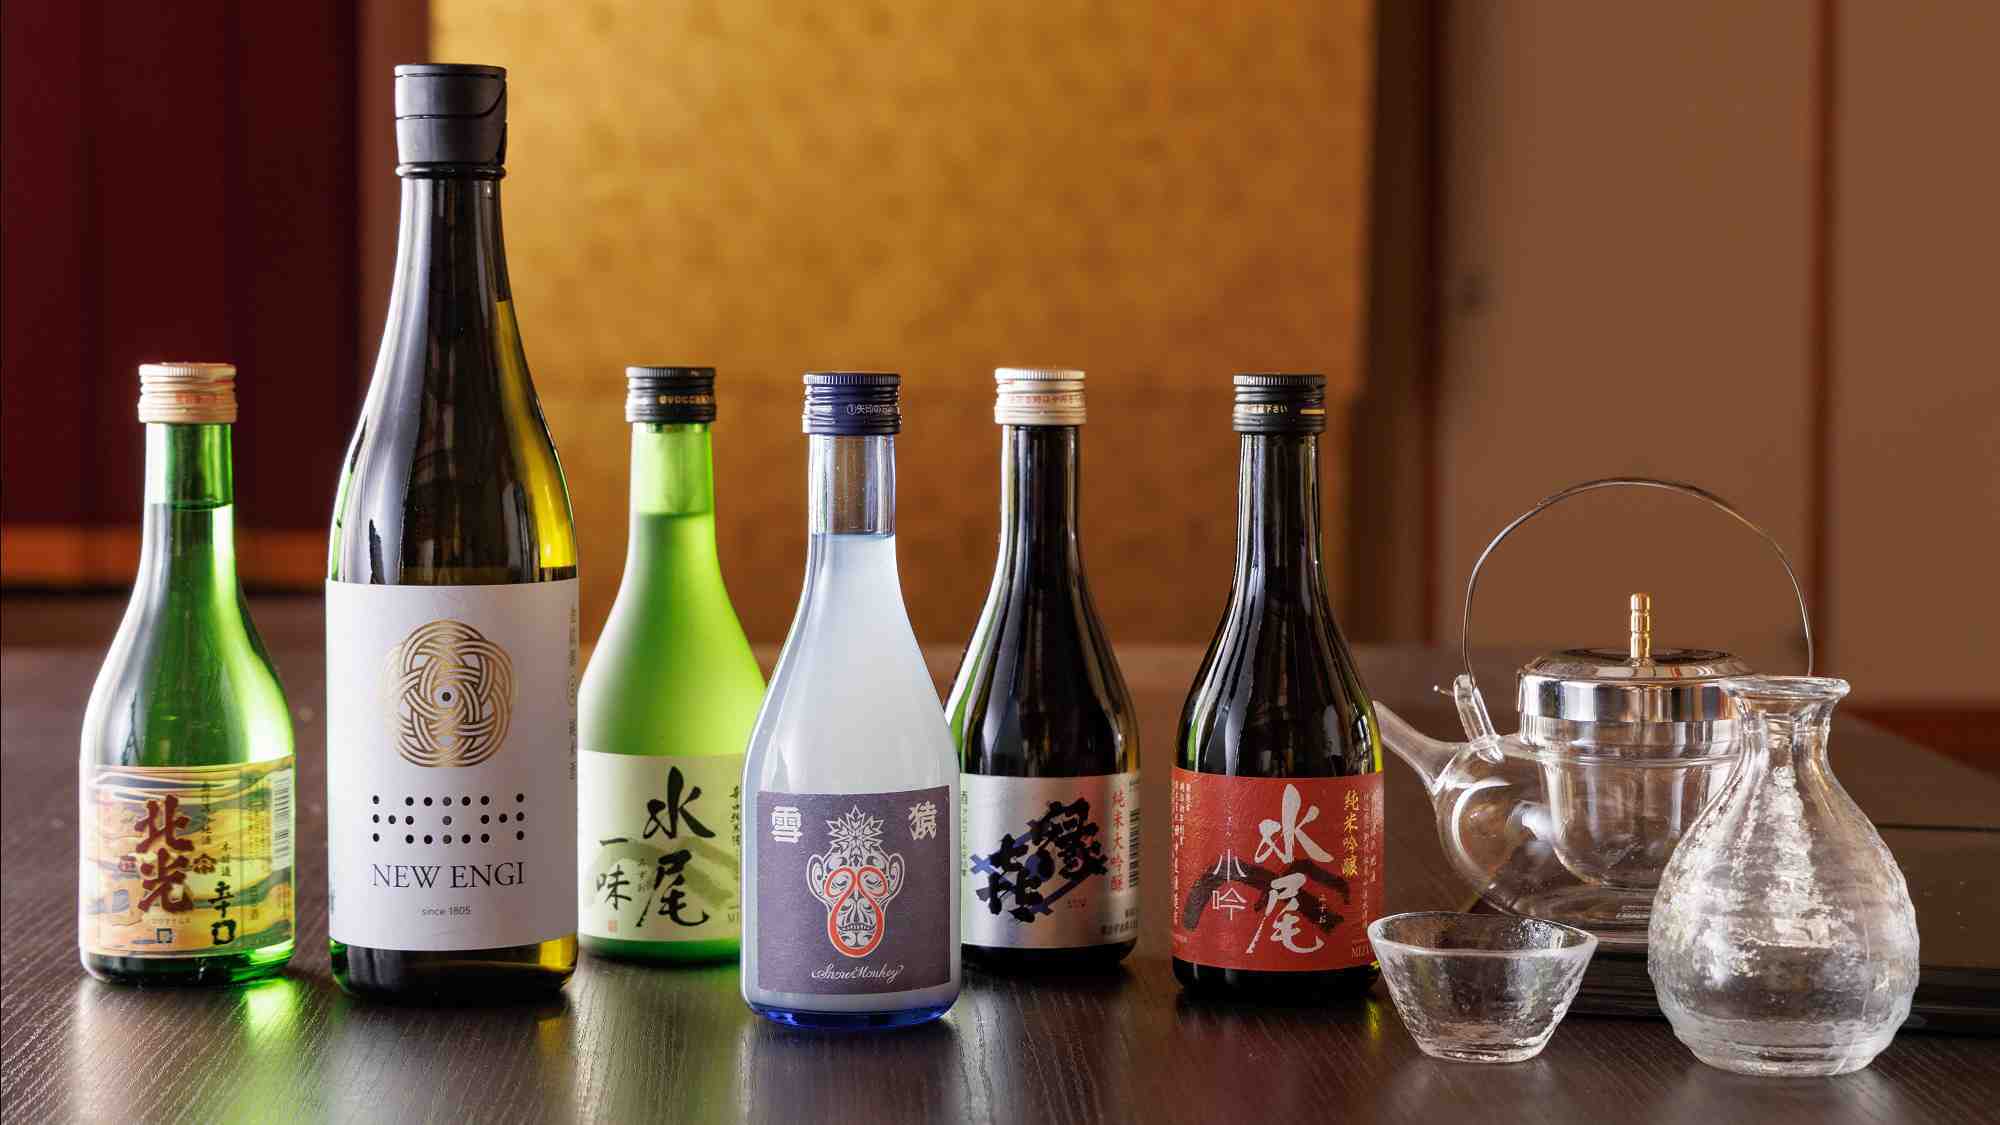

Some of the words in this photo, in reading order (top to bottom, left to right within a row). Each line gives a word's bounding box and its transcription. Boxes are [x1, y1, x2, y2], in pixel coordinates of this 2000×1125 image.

[135, 794, 194, 912] 北光
[371, 863, 440, 888] NEW
[449, 861, 524, 888] ENGI
[596, 836, 632, 911] 一味
[635, 766, 717, 928] 水尾
[1245, 783, 1334, 954] 水尾
[1342, 789, 1361, 881] 純米吟醸
[207, 880, 235, 945] 辛口
[421, 908, 444, 916] since
[448, 904, 472, 915] 1805
